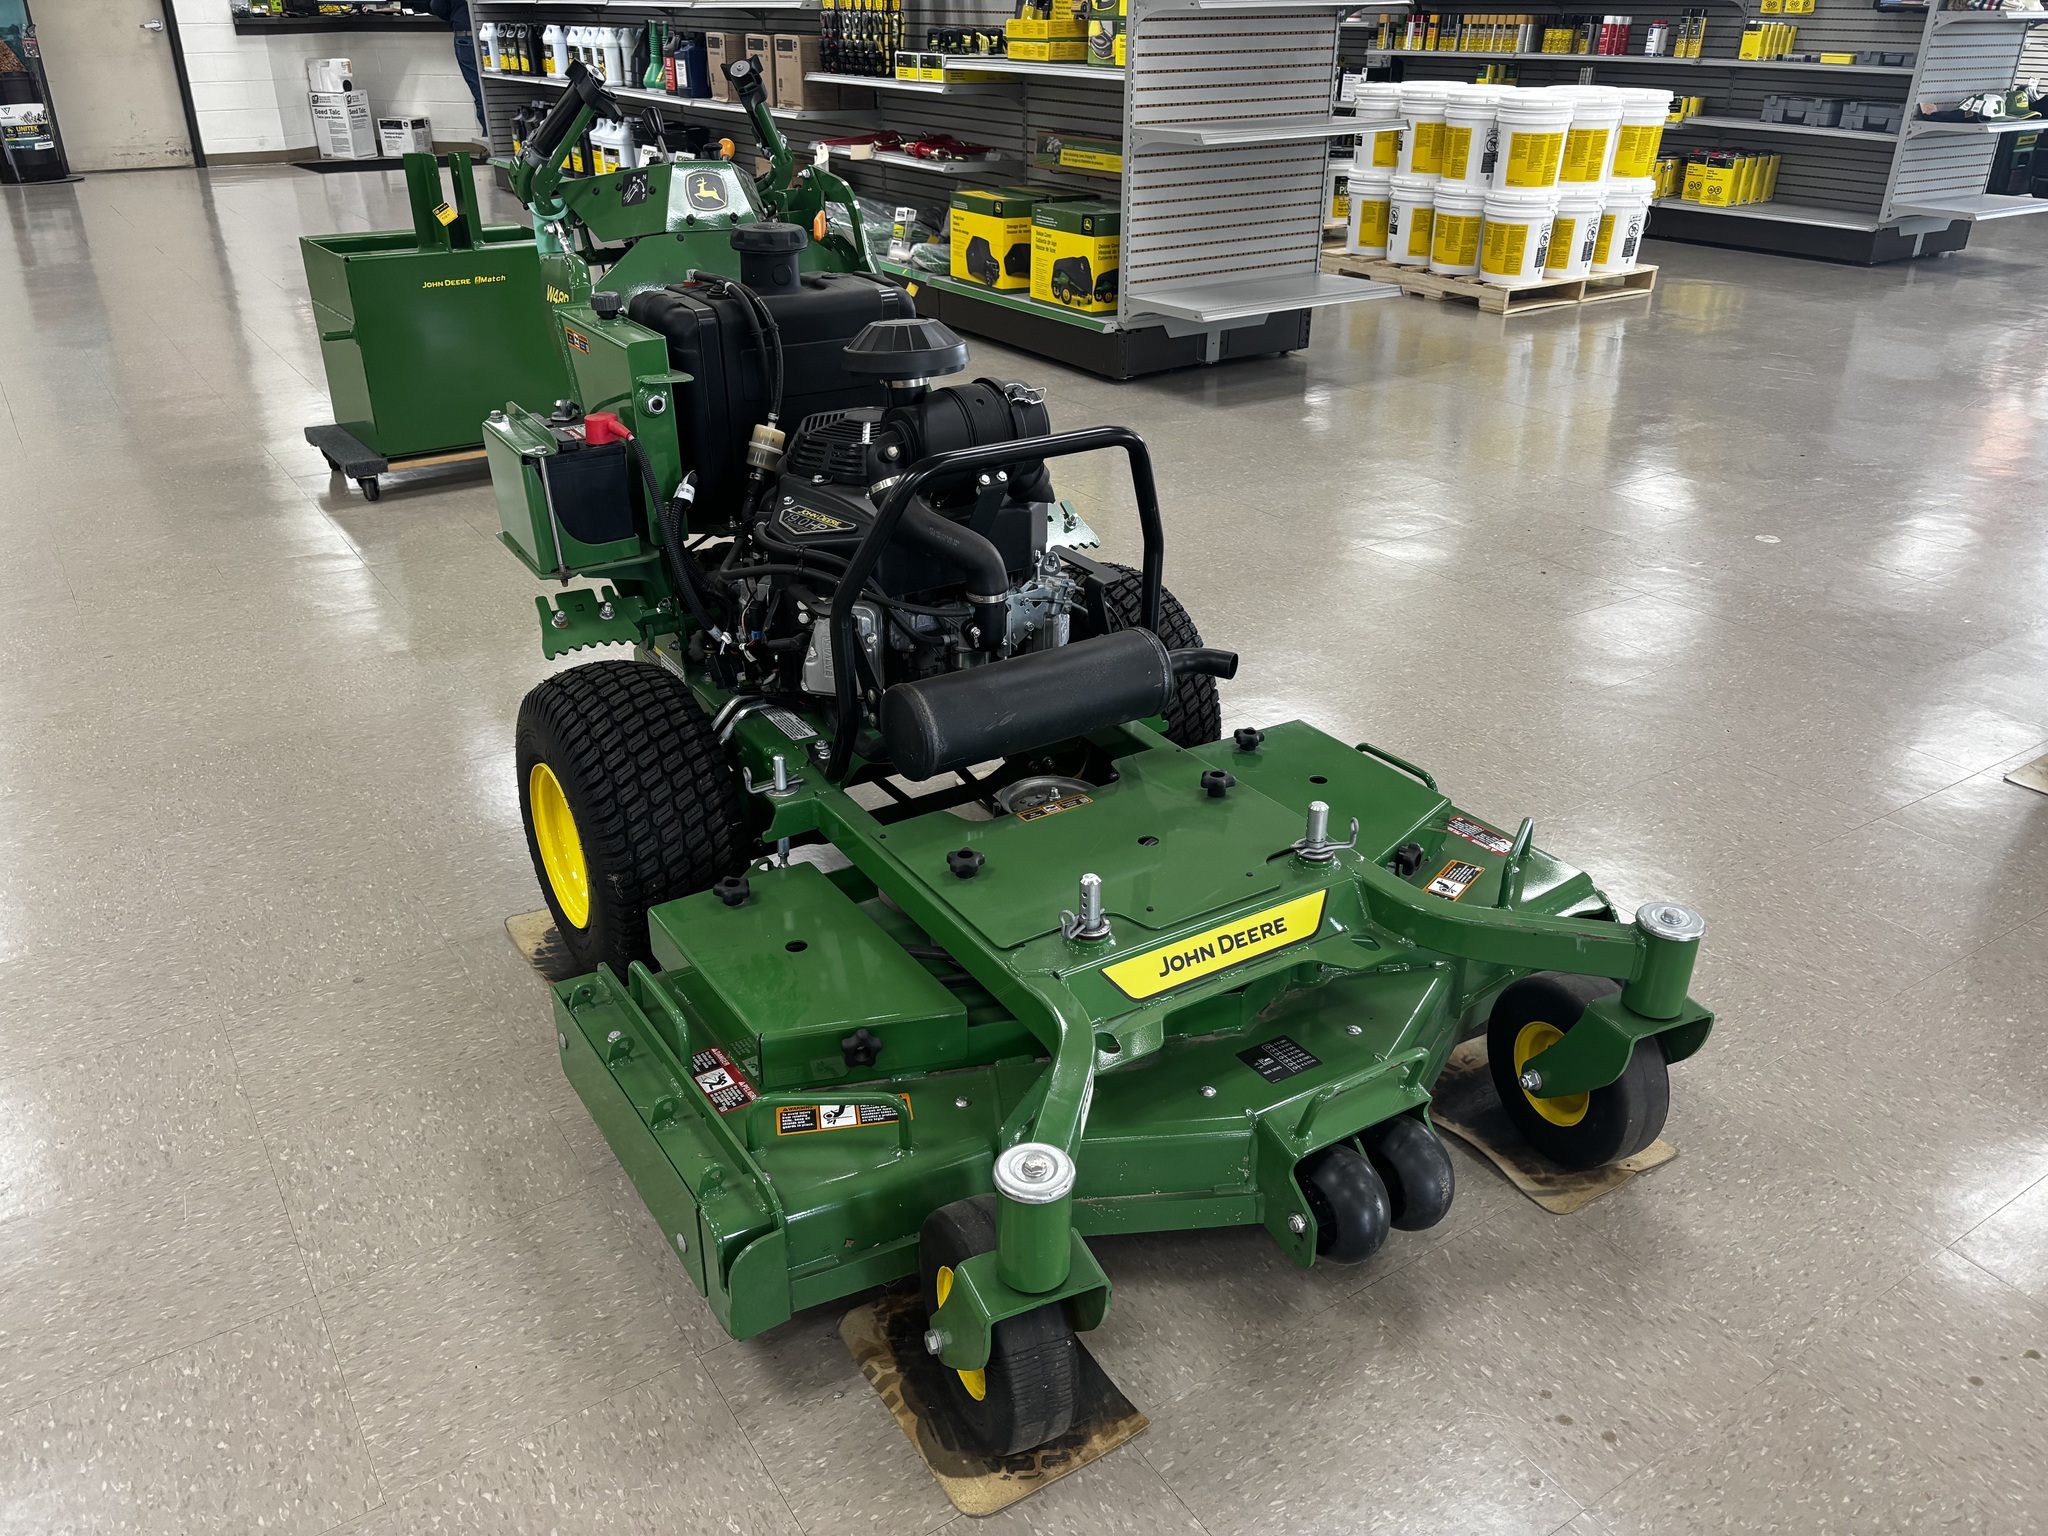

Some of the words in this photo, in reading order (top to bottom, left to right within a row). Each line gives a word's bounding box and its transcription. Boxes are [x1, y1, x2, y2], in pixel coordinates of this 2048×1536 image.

[444, 278, 471, 286] DEERE
[797, 509, 818, 520] JOHN
[816, 514, 842, 527] DEERE
[1159, 943, 1216, 978] JOHN
[1217, 917, 1288, 954] DEERE
[714, 1051, 730, 1066] DANGER
[742, 1084, 758, 1100] PELIGR
